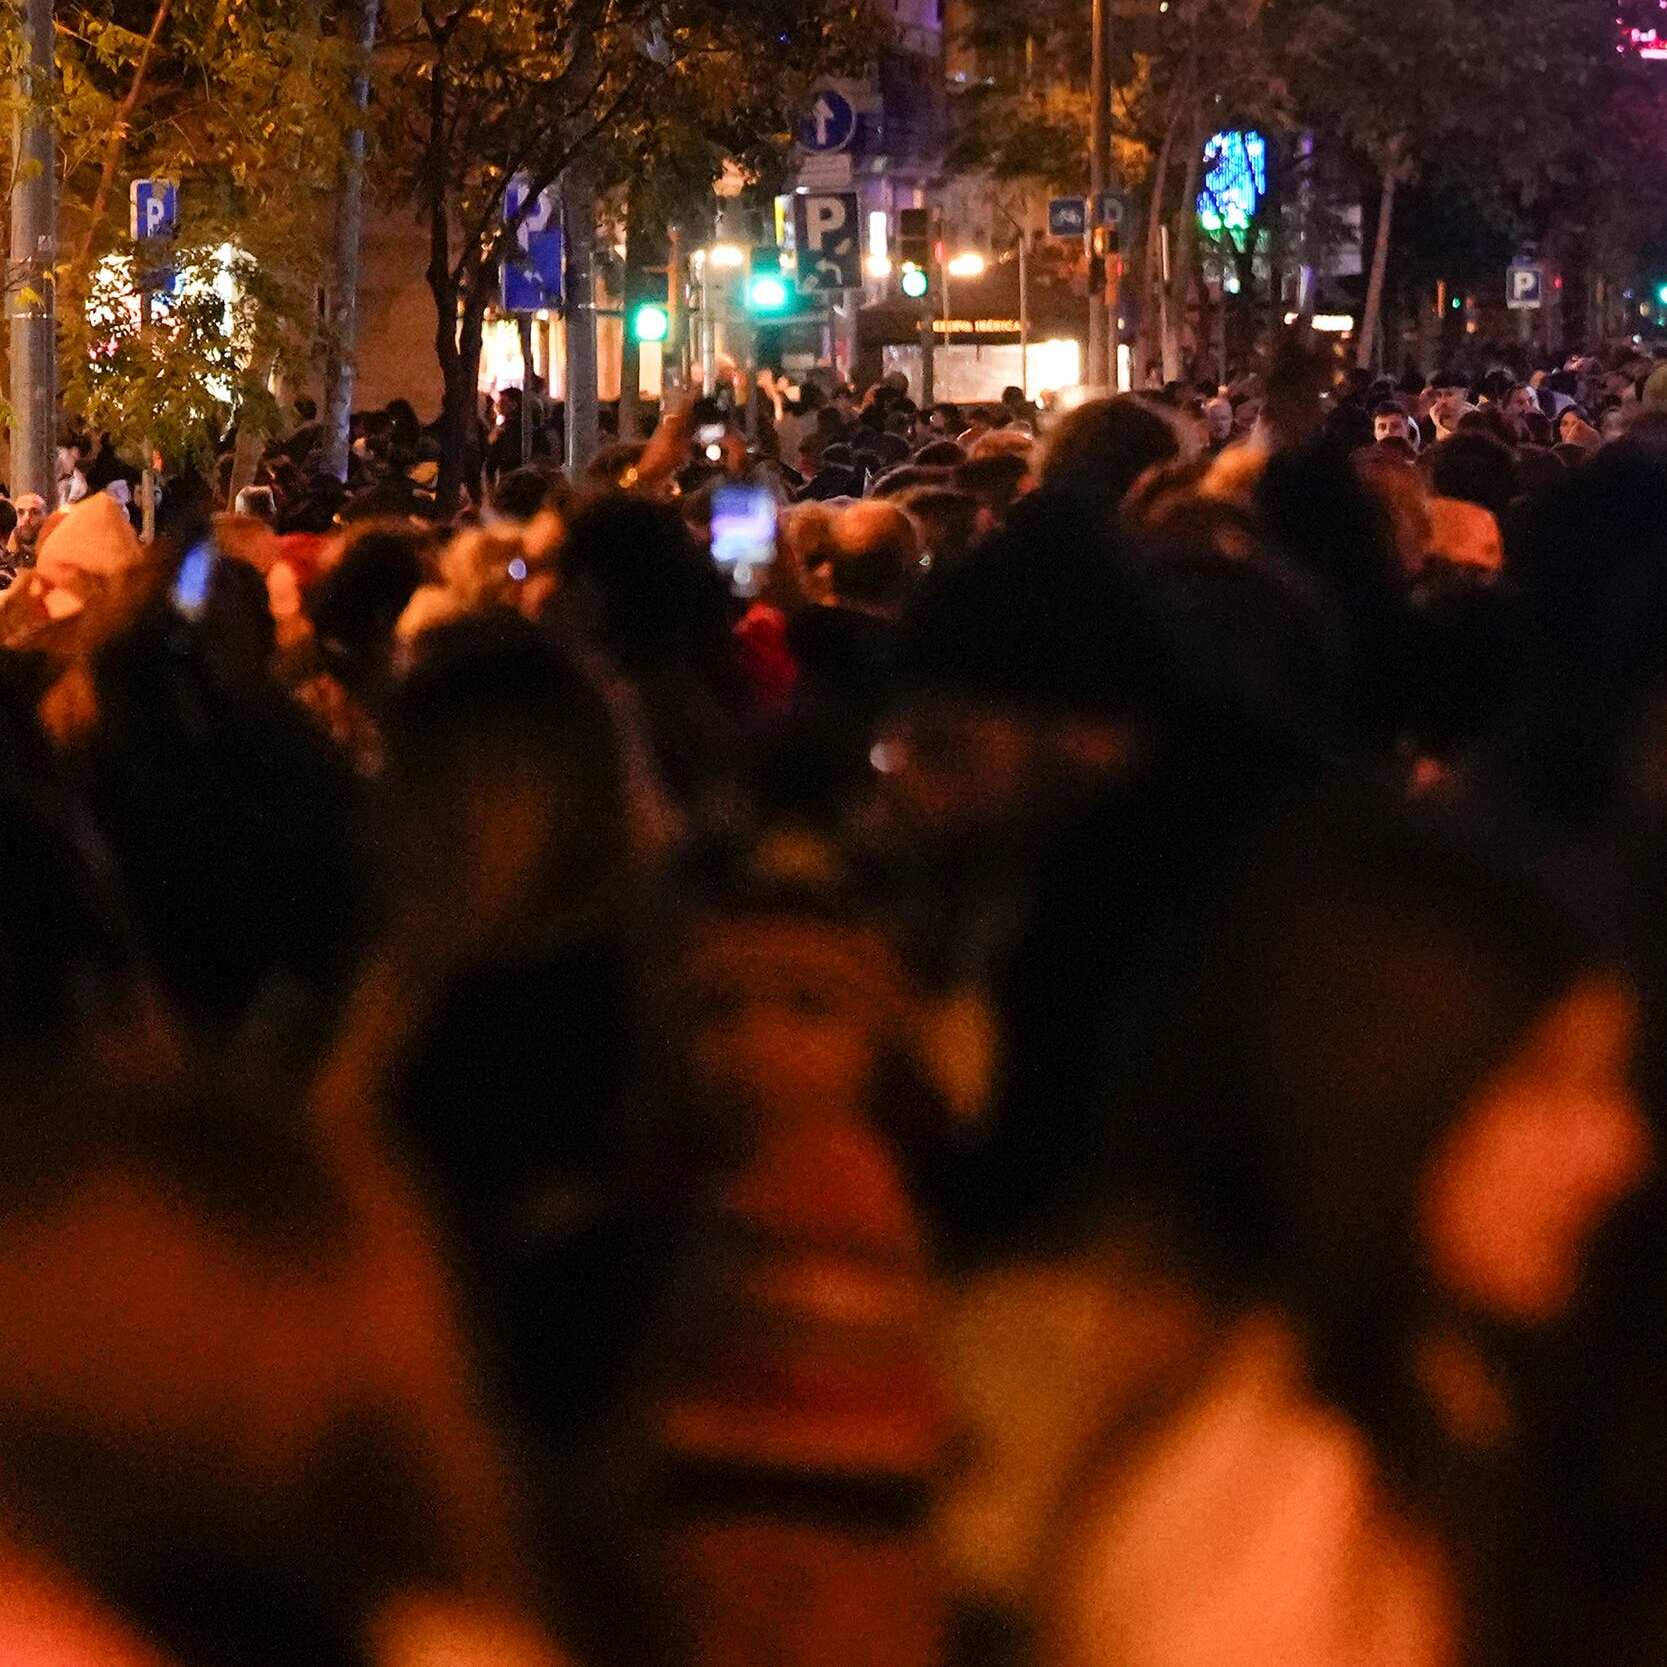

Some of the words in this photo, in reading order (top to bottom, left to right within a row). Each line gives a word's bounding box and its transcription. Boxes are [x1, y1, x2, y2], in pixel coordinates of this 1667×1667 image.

[146, 197, 165, 238] P
[805, 196, 847, 252] P
[1513, 271, 1536, 300] P
